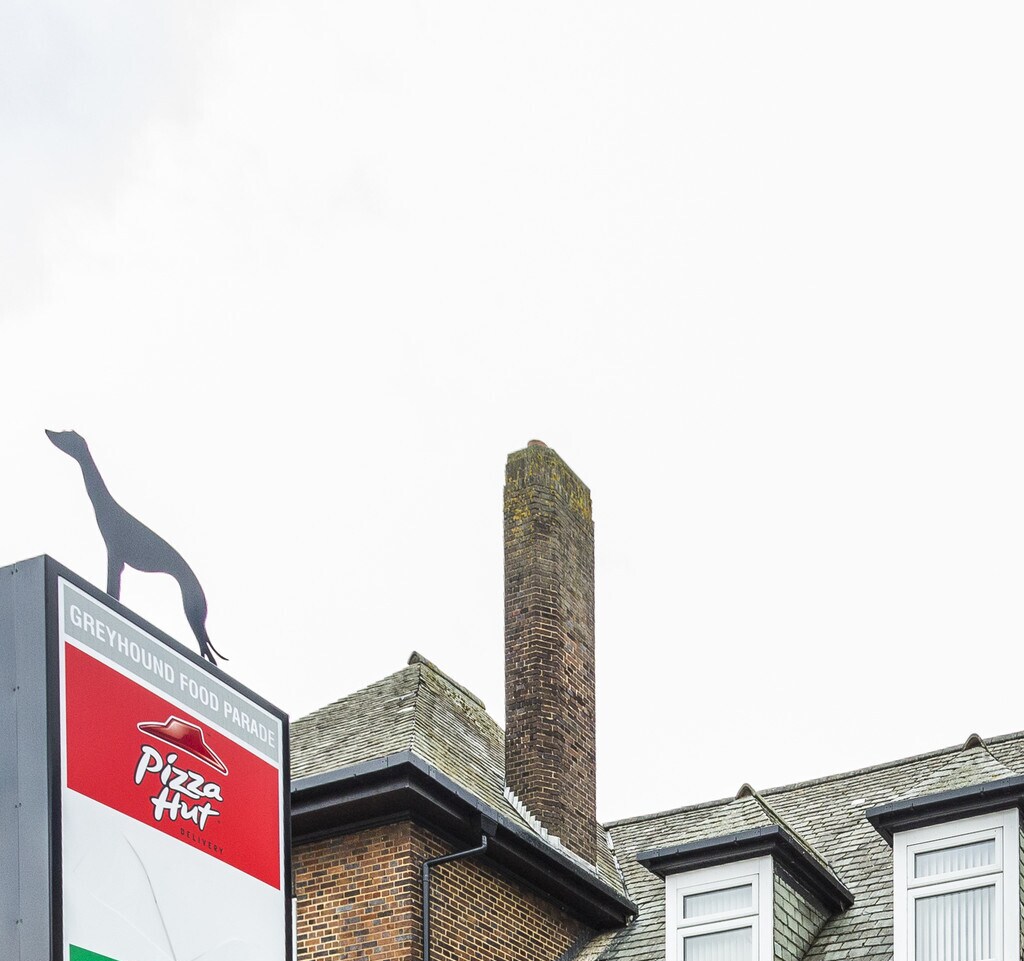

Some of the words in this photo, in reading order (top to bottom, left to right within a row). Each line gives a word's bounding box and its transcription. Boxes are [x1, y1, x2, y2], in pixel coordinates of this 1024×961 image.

[70, 604, 175, 684] GREYHOUND
[180, 672, 219, 712] FOOD
[224, 702, 275, 749] PARADE
[134, 745, 224, 802] Pizza
[151, 786, 220, 831] Hut
[180, 827, 223, 854] DELIVERY
